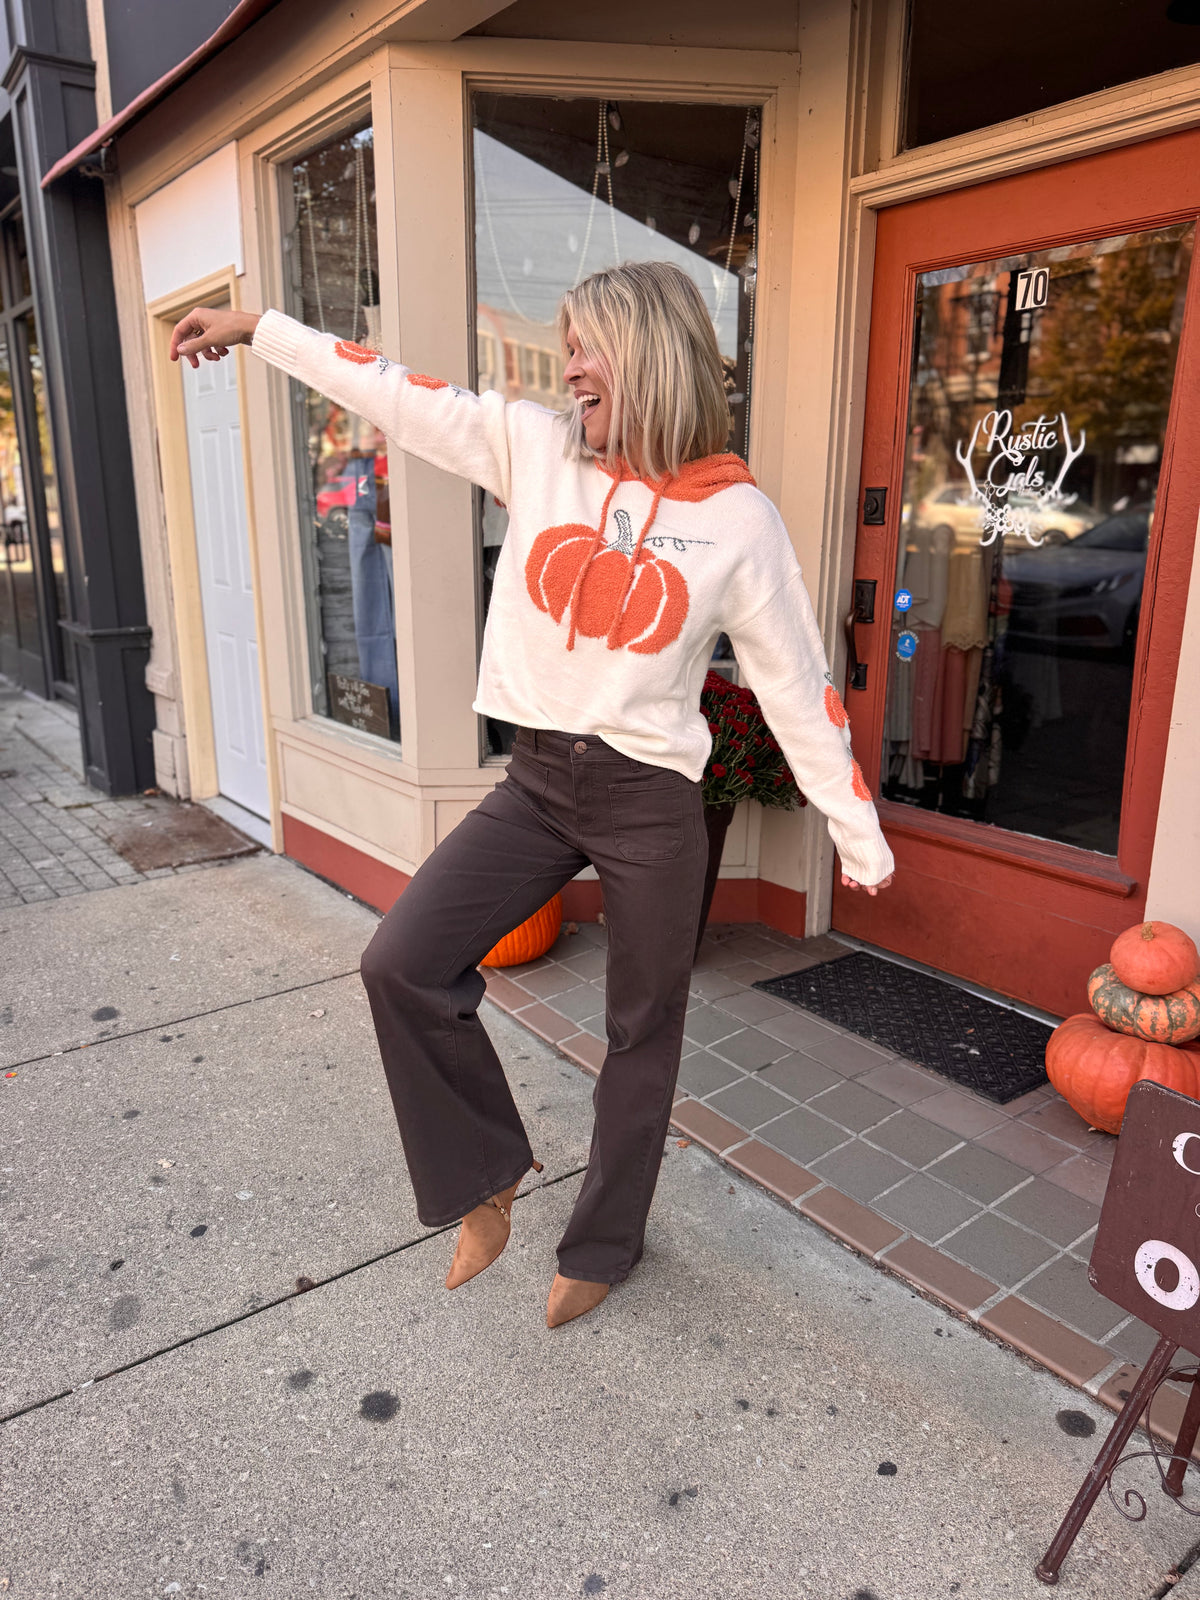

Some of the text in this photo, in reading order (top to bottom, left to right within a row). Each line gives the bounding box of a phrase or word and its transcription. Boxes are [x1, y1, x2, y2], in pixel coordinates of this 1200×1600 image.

[1019, 270, 1048, 309] 70
[982, 409, 1059, 466] Rustic
[987, 451, 1045, 497] Gals
[896, 595, 910, 604] ADT
